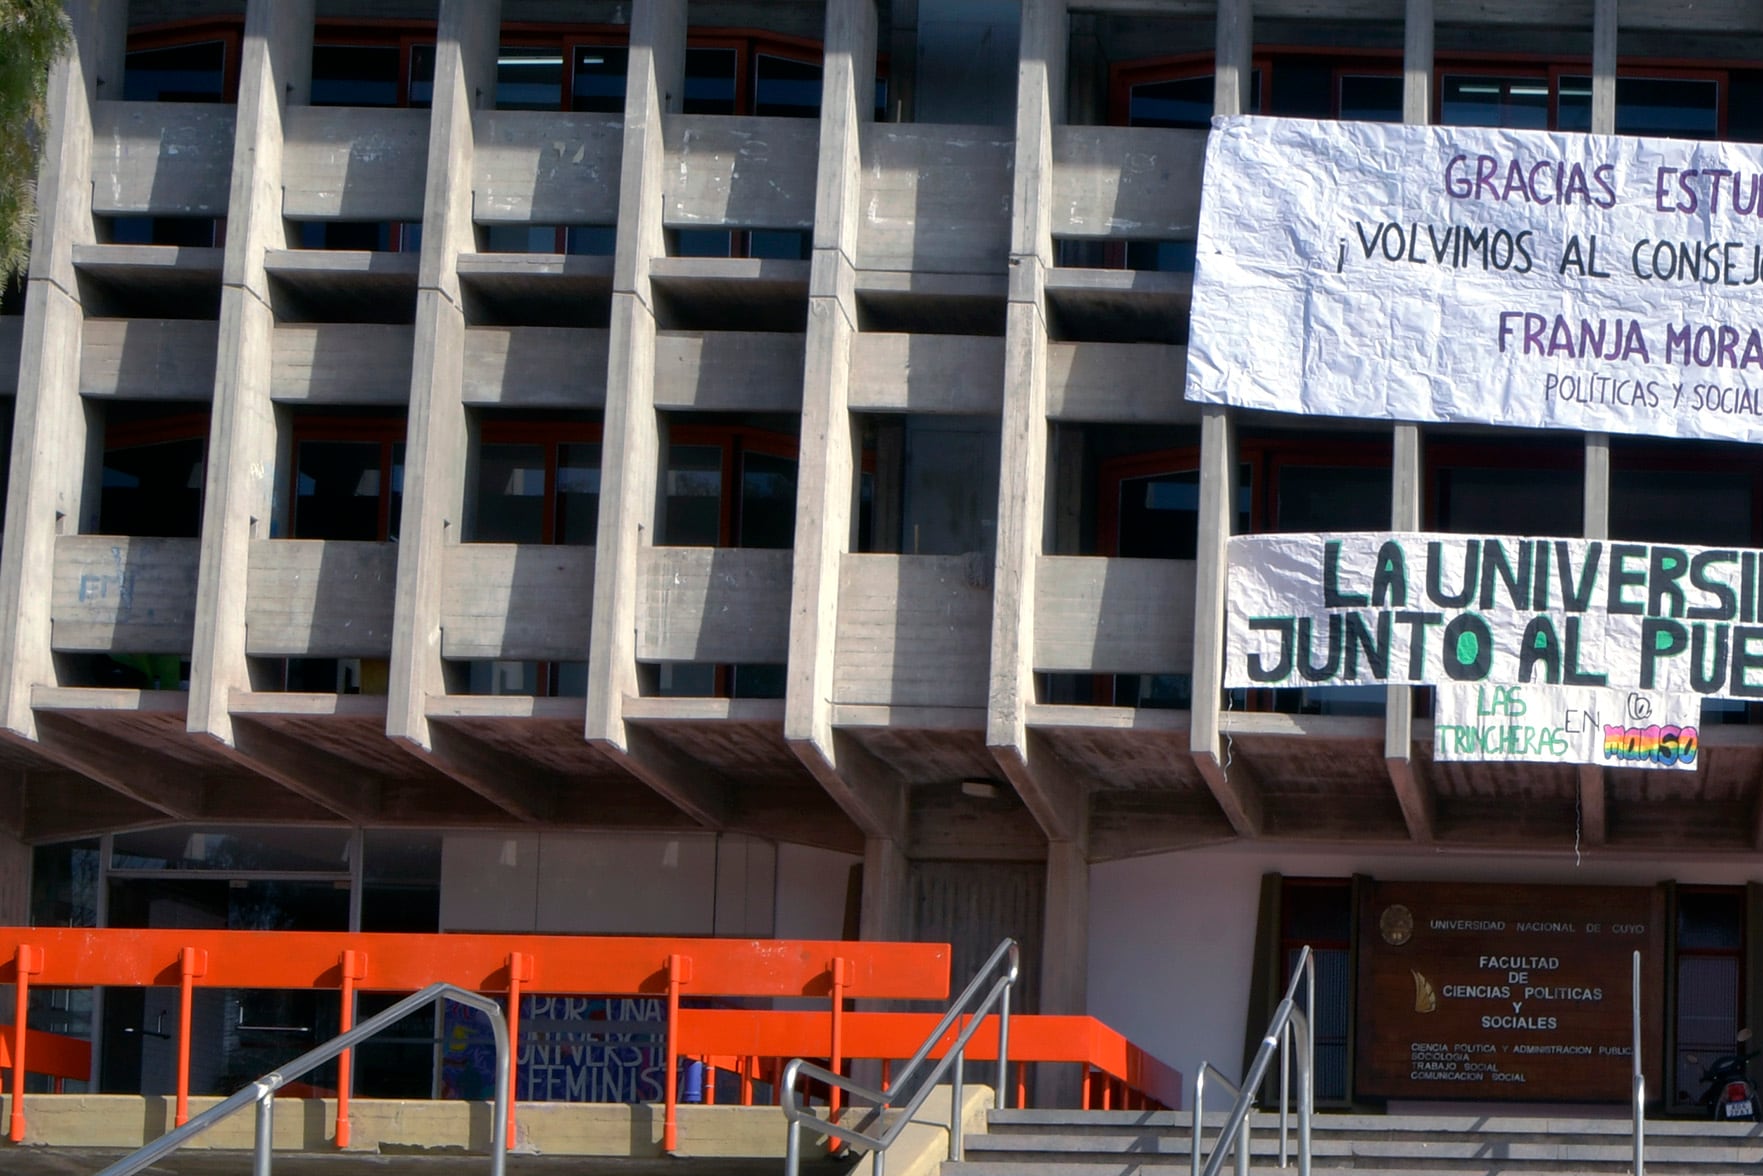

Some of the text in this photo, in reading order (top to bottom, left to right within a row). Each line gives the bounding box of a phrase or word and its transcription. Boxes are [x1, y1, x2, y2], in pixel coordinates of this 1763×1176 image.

[1445, 154, 1616, 209] GRACIAS
[1559, 235, 1610, 278] AL
[1500, 311, 1650, 364] FRANJA
[1545, 371, 1660, 409] POLÍTICAS
[1672, 383, 1684, 409] Y
[1324, 539, 1404, 610] LA
[1247, 610, 1494, 683] JUNTO
[1518, 614, 1609, 686] AL
[1477, 685, 1527, 717] LAS
[1565, 709, 1600, 733] EN
[1435, 724, 1569, 756] TRINCHERAS
[1430, 919, 1644, 934] UNIVERSIDAD NACIONAL DE CUYO
[1479, 956, 1559, 970] FACULTAD
[1508, 972, 1528, 984] DE
[1443, 985, 1603, 1000] CIENCIAS POLITICAS
[530, 994, 662, 1022] POR UNA
[1512, 1002, 1523, 1014] Y
[1481, 1016, 1558, 1030] SOCIALES
[1411, 1042, 1448, 1052] CIENCIA
[1454, 1043, 1496, 1053] POLITICA
[1513, 1045, 1592, 1055] ADMINISTRACION
[1599, 1046, 1633, 1056] PUBLIC
[1411, 1052, 1470, 1062] SOCIOLOGIA
[1411, 1061, 1499, 1072] TRABAJO SOCIAL
[1410, 1071, 1526, 1082] COMUNICACION SOCIAL
